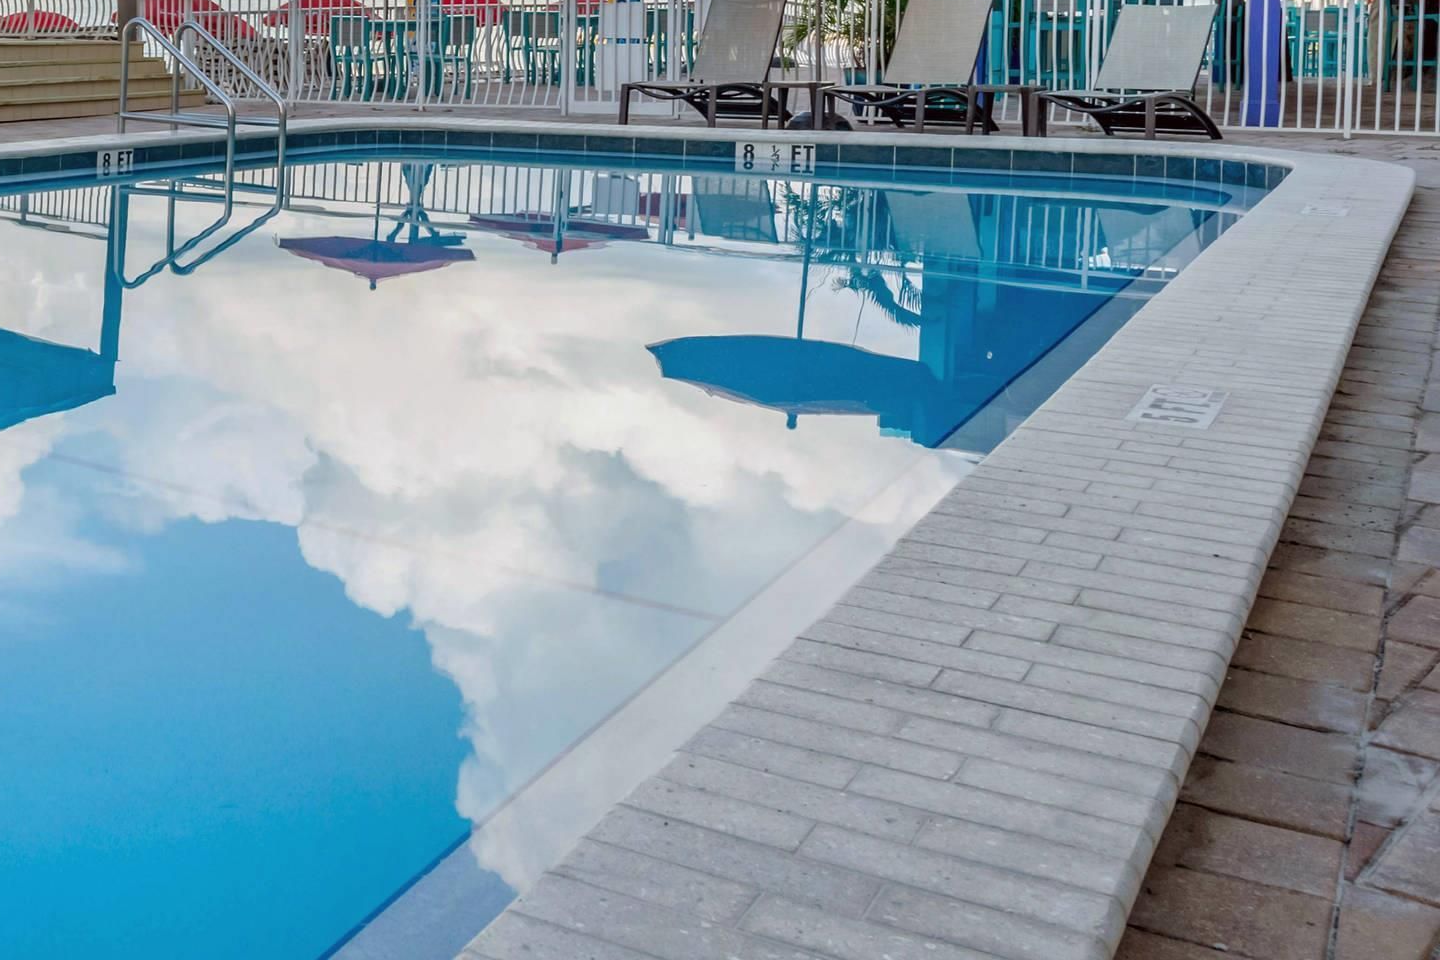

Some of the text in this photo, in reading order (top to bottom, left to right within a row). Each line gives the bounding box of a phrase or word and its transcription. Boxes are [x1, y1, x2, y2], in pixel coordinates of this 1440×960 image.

[103, 150, 133, 168] 8 FT
[743, 144, 755, 160] 8
[791, 145, 814, 162] FT
